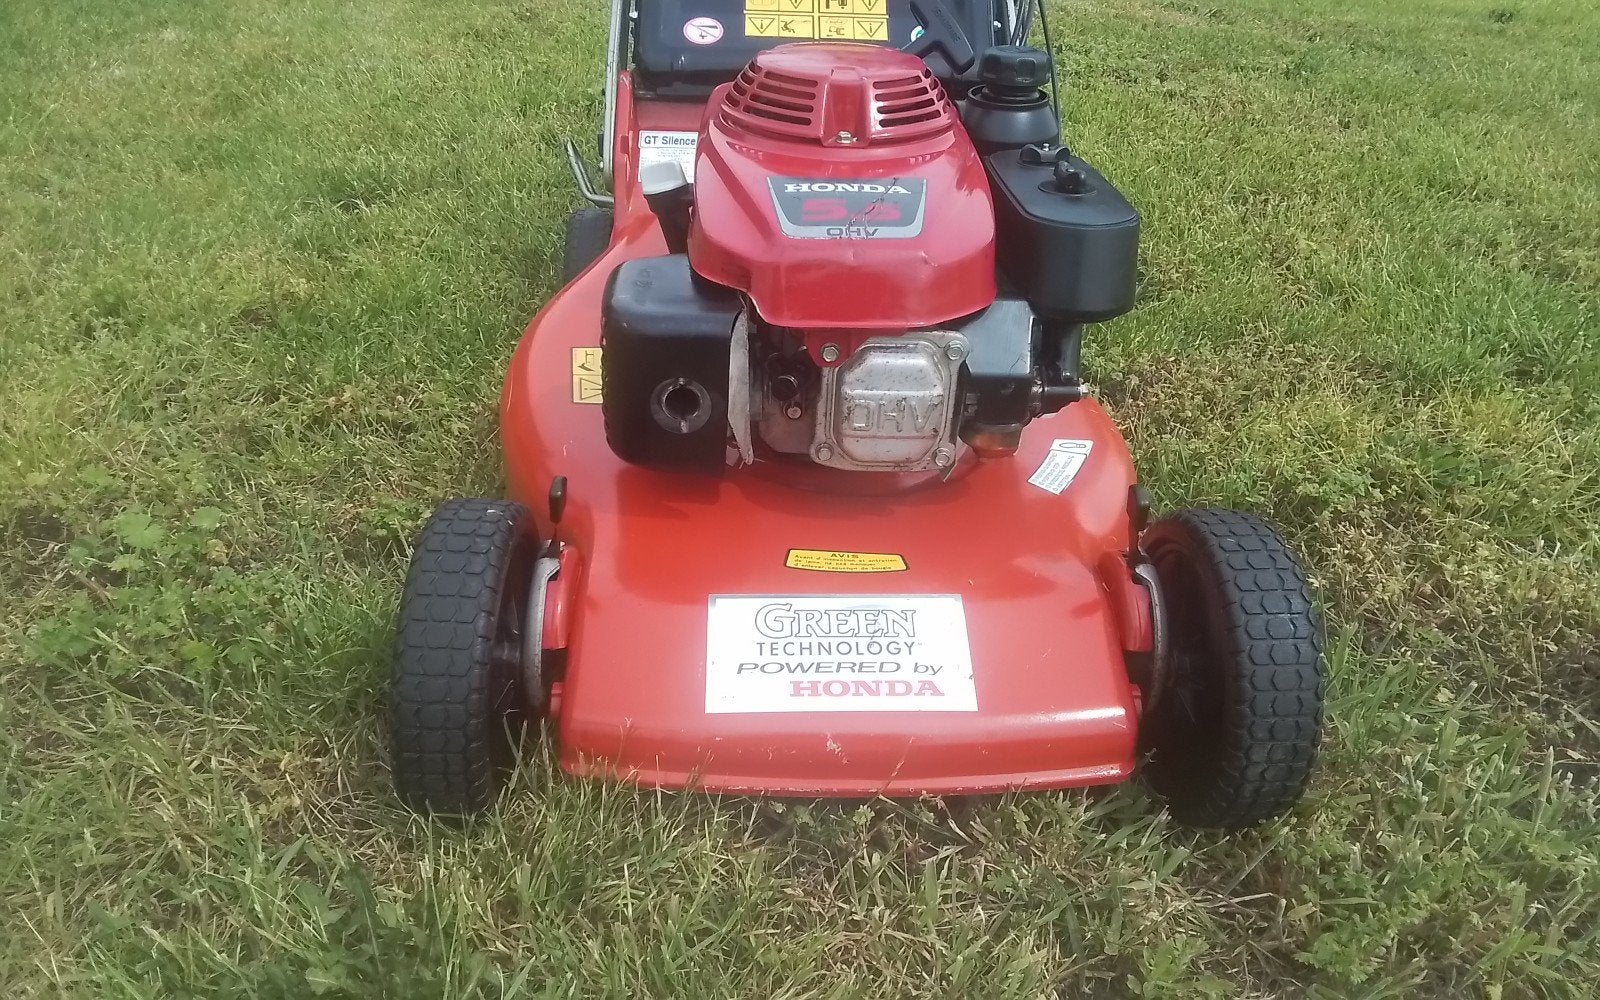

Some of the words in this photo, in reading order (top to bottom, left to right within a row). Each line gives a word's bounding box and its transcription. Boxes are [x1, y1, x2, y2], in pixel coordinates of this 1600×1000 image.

[644, 135, 658, 145] GT
[661, 135, 696, 146] Silence
[784, 182, 911, 195] HONDA
[826, 226, 879, 238] OHV
[843, 395, 944, 433] OHV
[755, 602, 917, 639] GREEN
[756, 641, 916, 656] TECHNOLOGY
[736, 661, 901, 675] POWERED
[913, 661, 943, 676] by
[789, 680, 945, 697] HONDA
